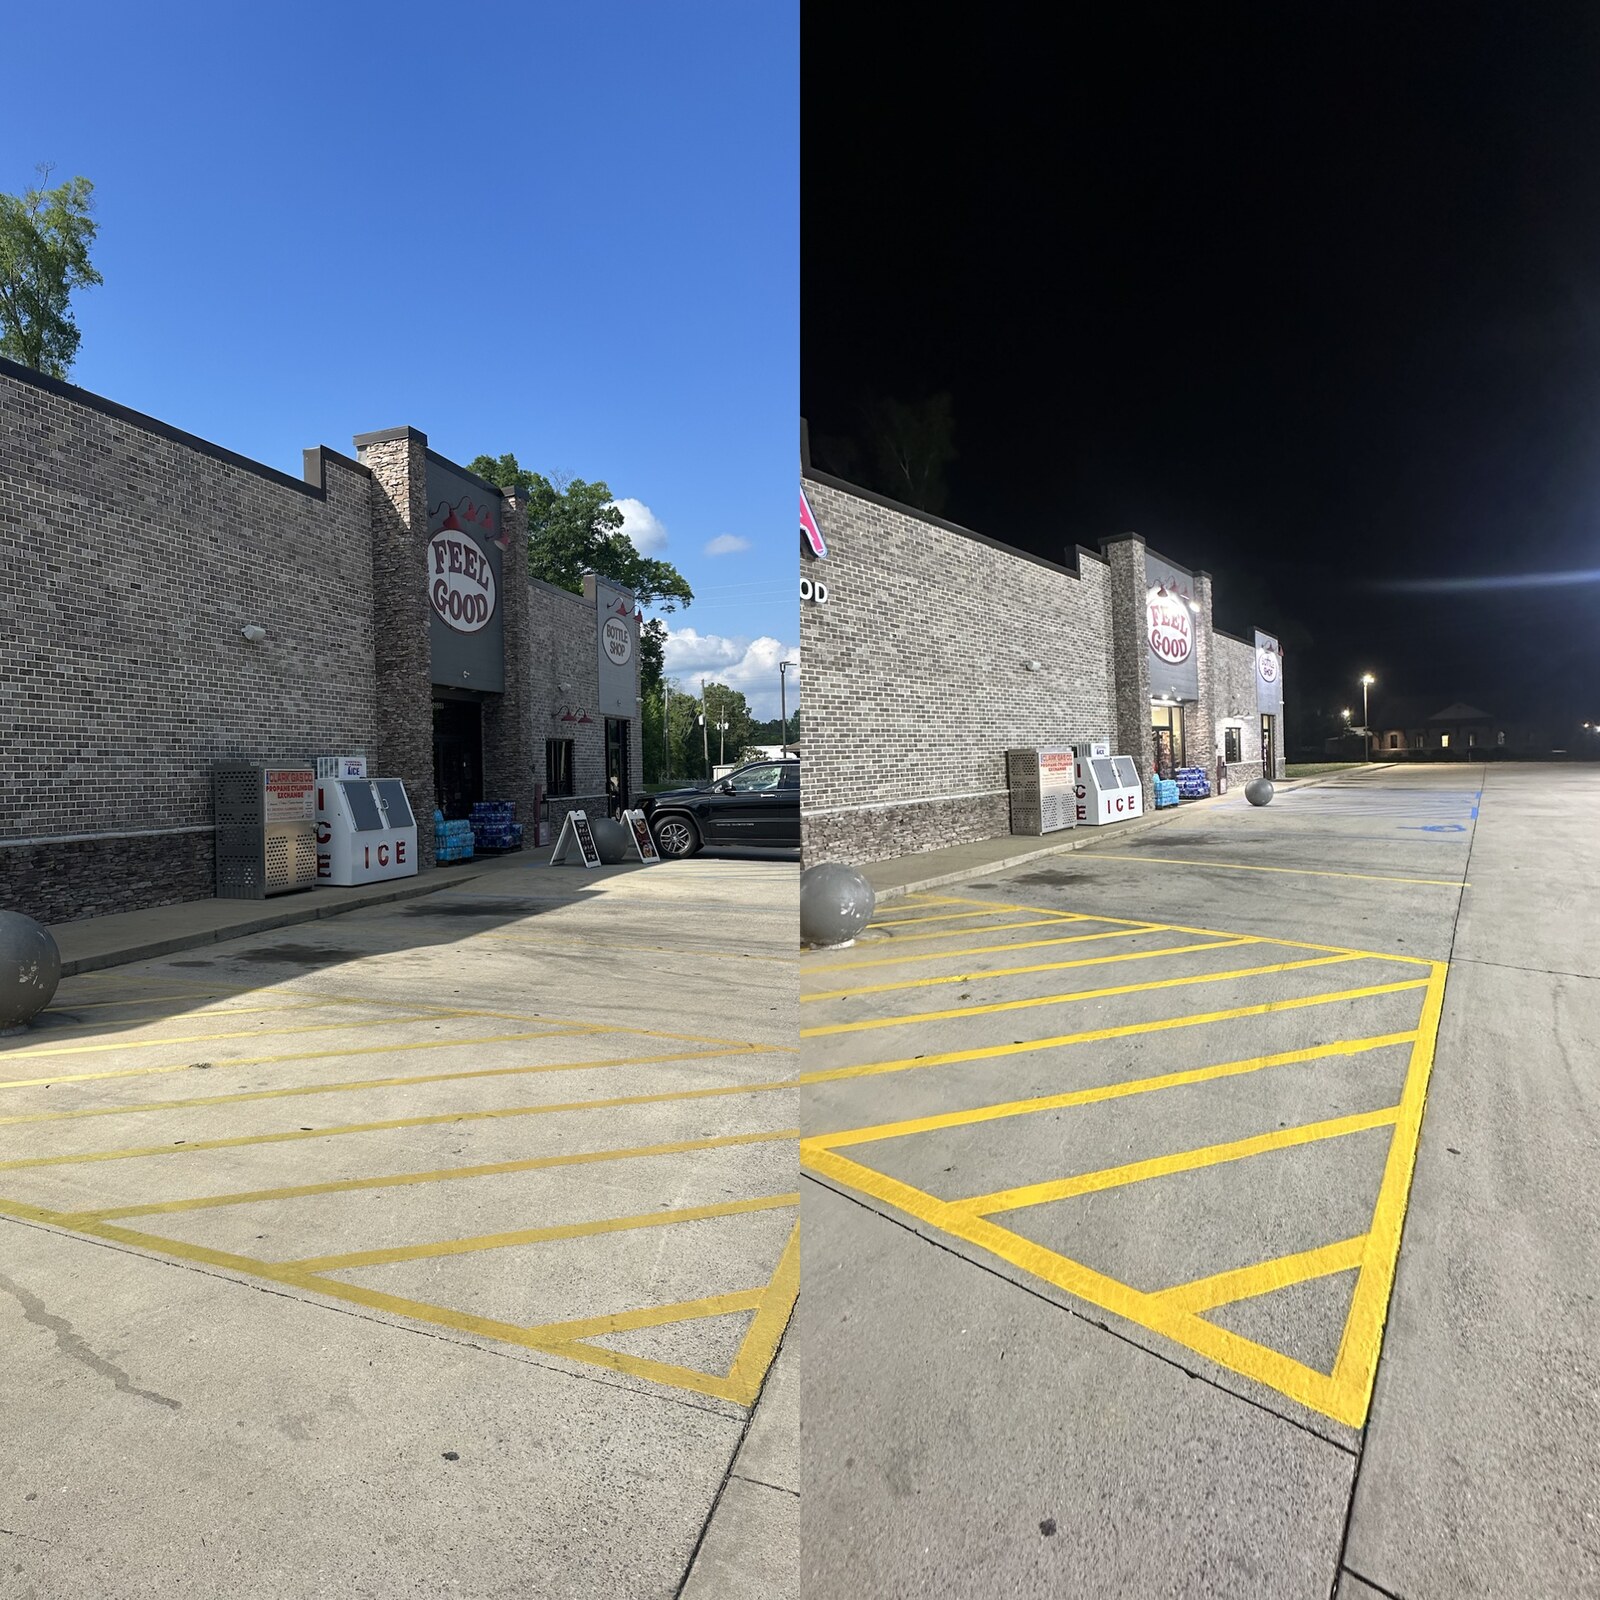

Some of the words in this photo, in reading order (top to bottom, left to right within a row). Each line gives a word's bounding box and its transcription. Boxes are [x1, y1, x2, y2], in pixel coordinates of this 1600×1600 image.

[432, 540, 489, 591] FEEL
[433, 578, 488, 624] GOOD
[606, 624, 628, 644] BOTTLE
[1150, 605, 1188, 637] FEEL
[610, 641, 626, 657] SHOP
[1151, 629, 1187, 658] GOOD
[269, 772, 290, 782] CLARK
[291, 772, 304, 783] GAS
[349, 767, 360, 775] ICE
[1076, 763, 1087, 820] ICE
[1107, 795, 1135, 814] ICE
[316, 788, 332, 878] ICE
[364, 841, 406, 869] ICE
